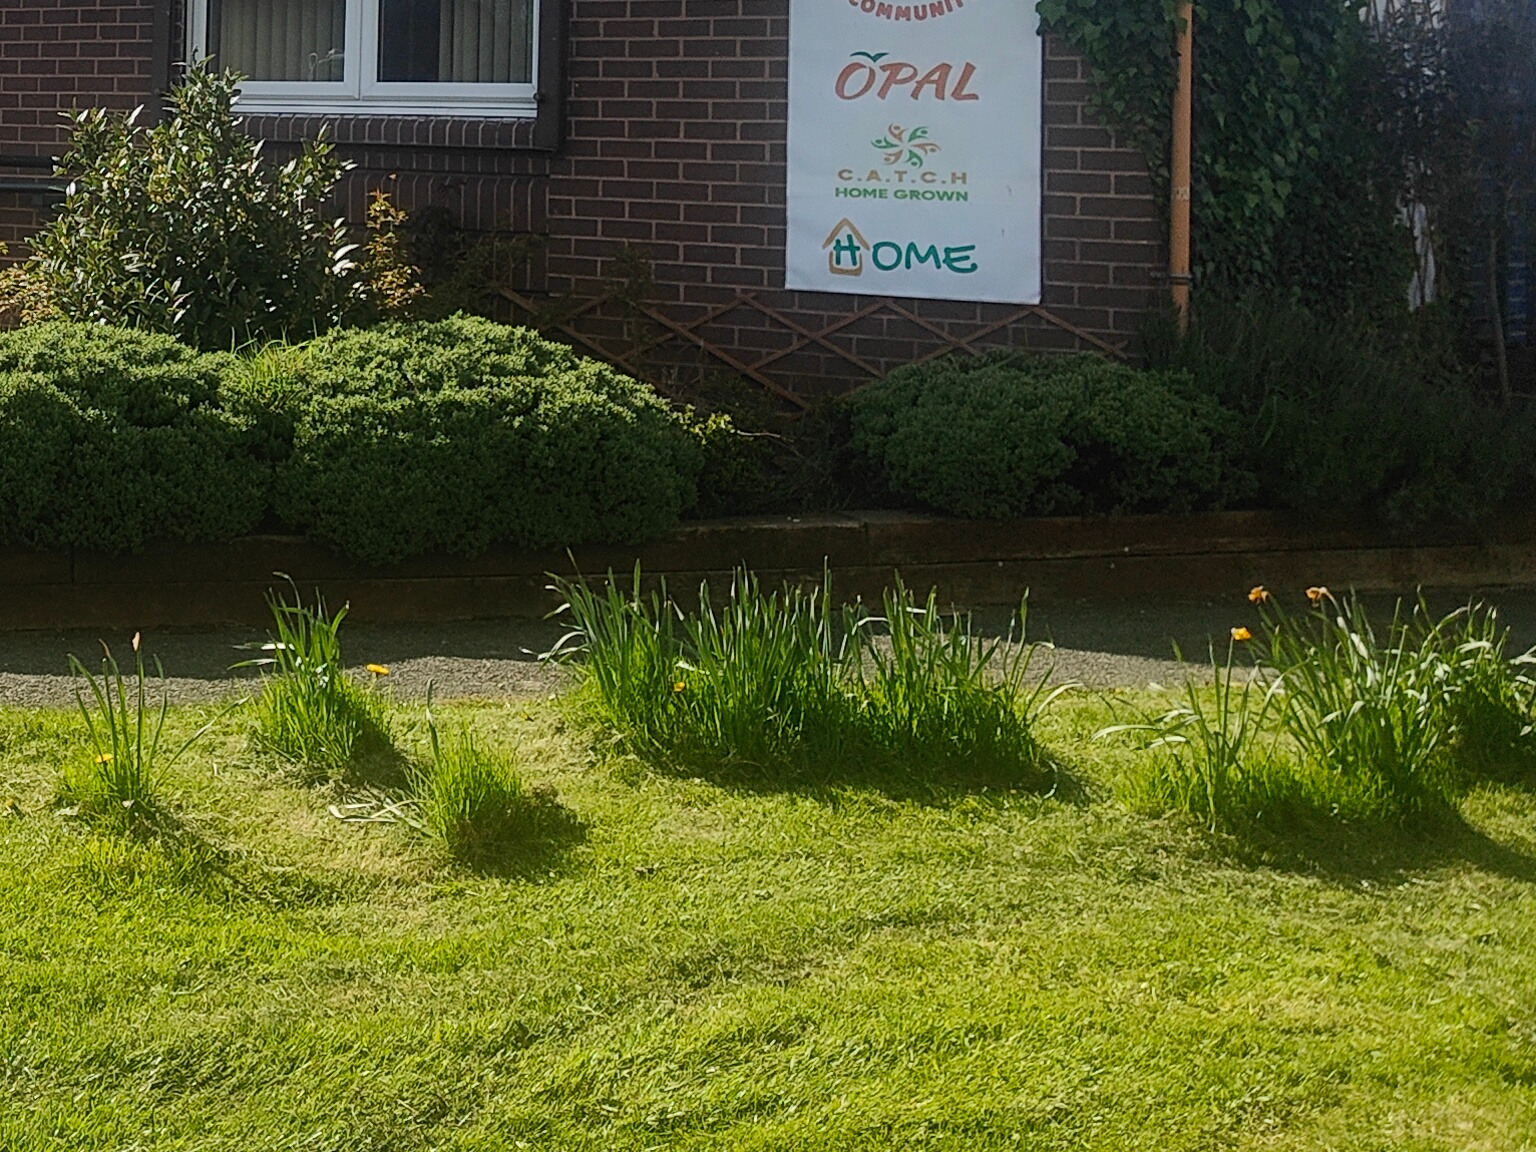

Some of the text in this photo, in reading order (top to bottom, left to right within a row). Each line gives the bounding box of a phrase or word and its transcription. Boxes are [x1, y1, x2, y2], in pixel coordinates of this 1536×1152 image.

[834, 61, 979, 101] OPAL
[834, 187, 968, 202] HOME GROWN
[831, 234, 978, 273] HOME
